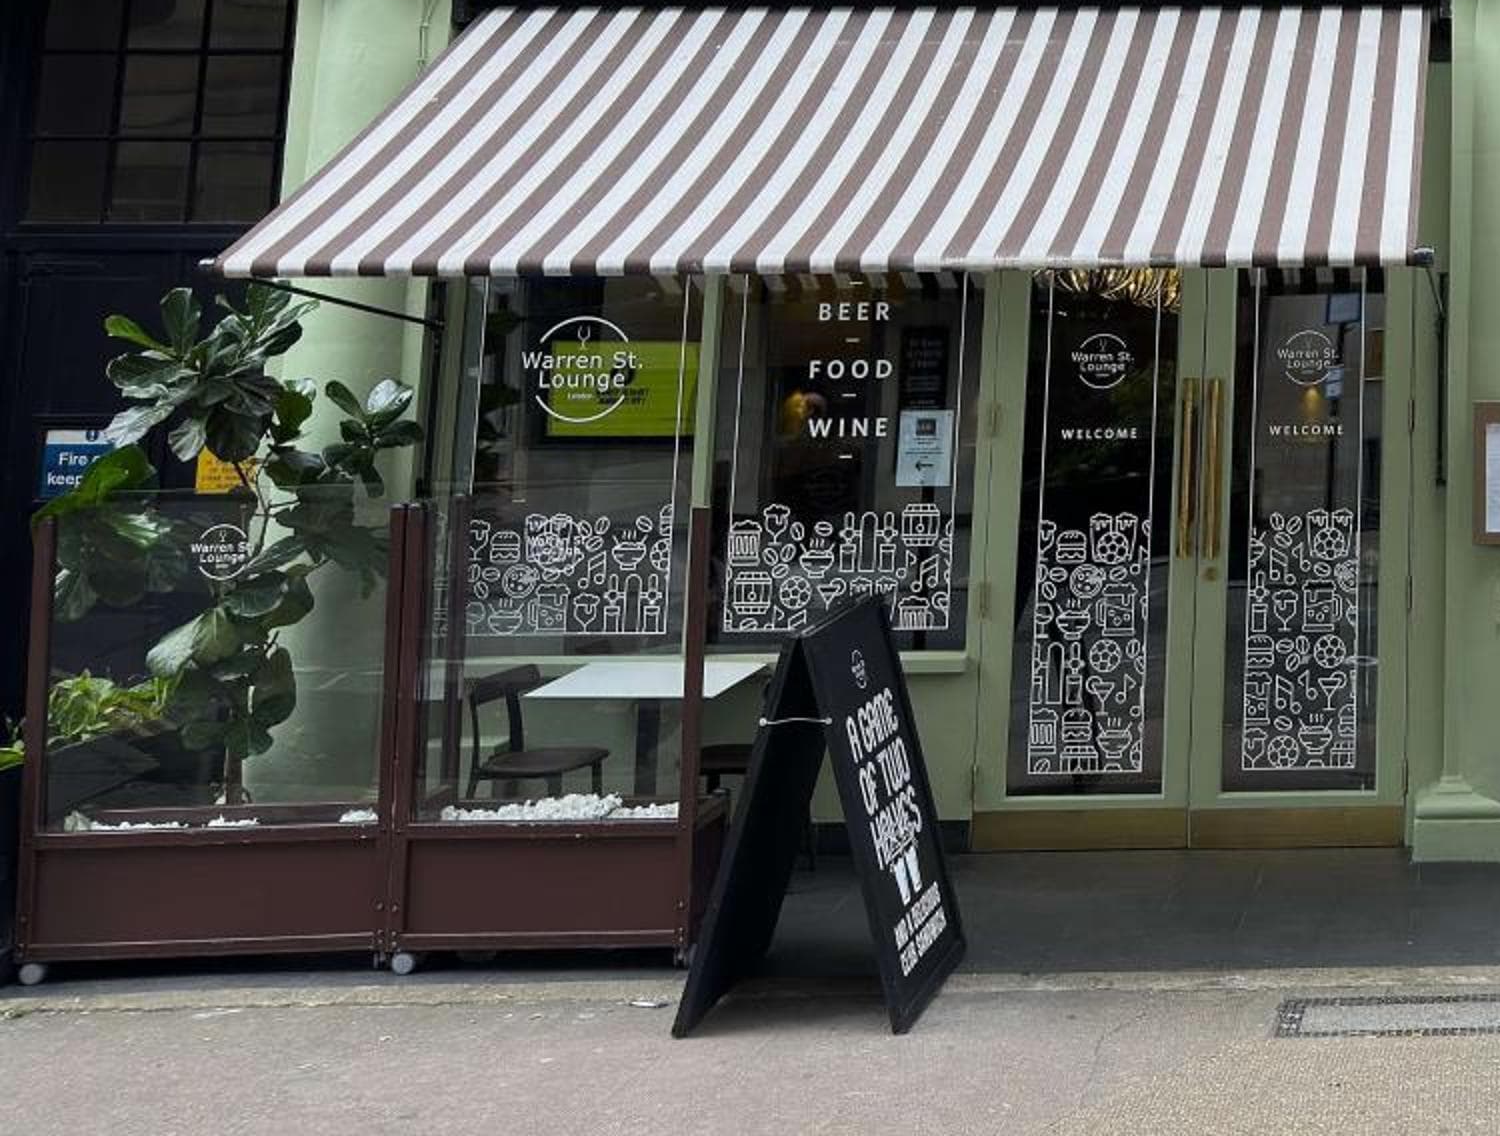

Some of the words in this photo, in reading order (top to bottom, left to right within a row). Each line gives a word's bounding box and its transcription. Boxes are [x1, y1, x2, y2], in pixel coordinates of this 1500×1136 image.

[818, 302, 890, 321] BEER
[522, 351, 602, 369] Warren
[613, 351, 644, 369] St.
[1071, 351, 1114, 362] Warren
[1277, 348, 1319, 359] Warren
[808, 359, 893, 379] FOOD
[1080, 362, 1125, 373] Lounge
[1287, 359, 1331, 371] Lounge
[539, 370, 626, 392] Lounge
[807, 417, 889, 438] WINE
[1061, 427, 1138, 440] WELCOME
[1268, 424, 1345, 436] WELCOME
[58, 451, 89, 466] Fire
[191, 543, 234, 553] Warren
[200, 553, 245, 564] Lounge
[846, 715, 863, 764] A
[857, 687, 898, 753] GAME
[859, 761, 879, 815] OF
[876, 736, 911, 797] TWO
